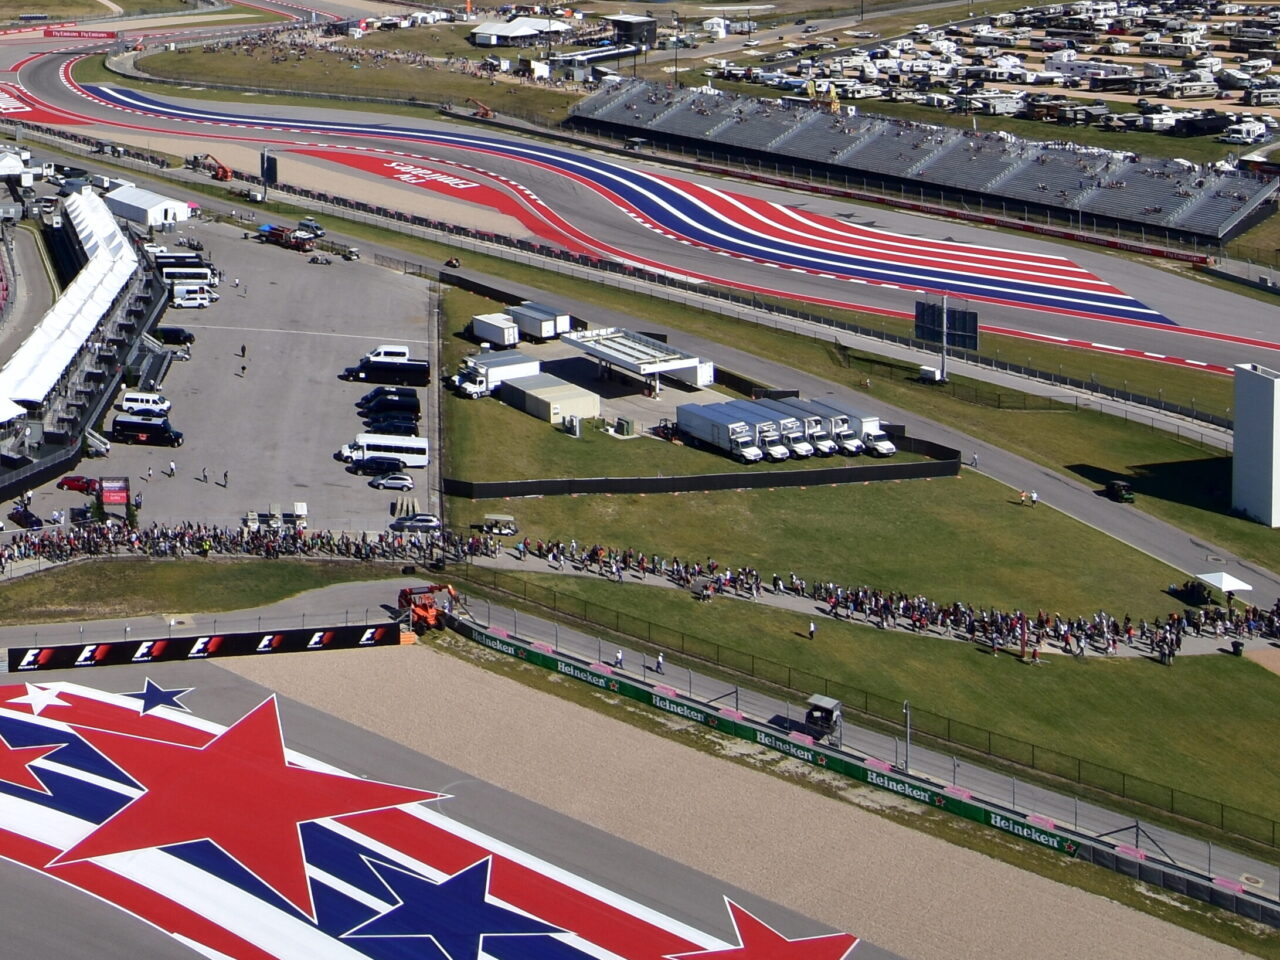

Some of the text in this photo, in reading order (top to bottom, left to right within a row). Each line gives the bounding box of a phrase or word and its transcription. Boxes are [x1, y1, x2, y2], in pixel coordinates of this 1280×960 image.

[383, 161, 480, 188] Emirates
[472, 629, 515, 654] Heineken
[557, 661, 606, 687] Heineken
[652, 695, 704, 722] Heineken
[756, 732, 813, 761] Heineken
[867, 771, 930, 802] Heineken
[990, 813, 1060, 849] Heineken
